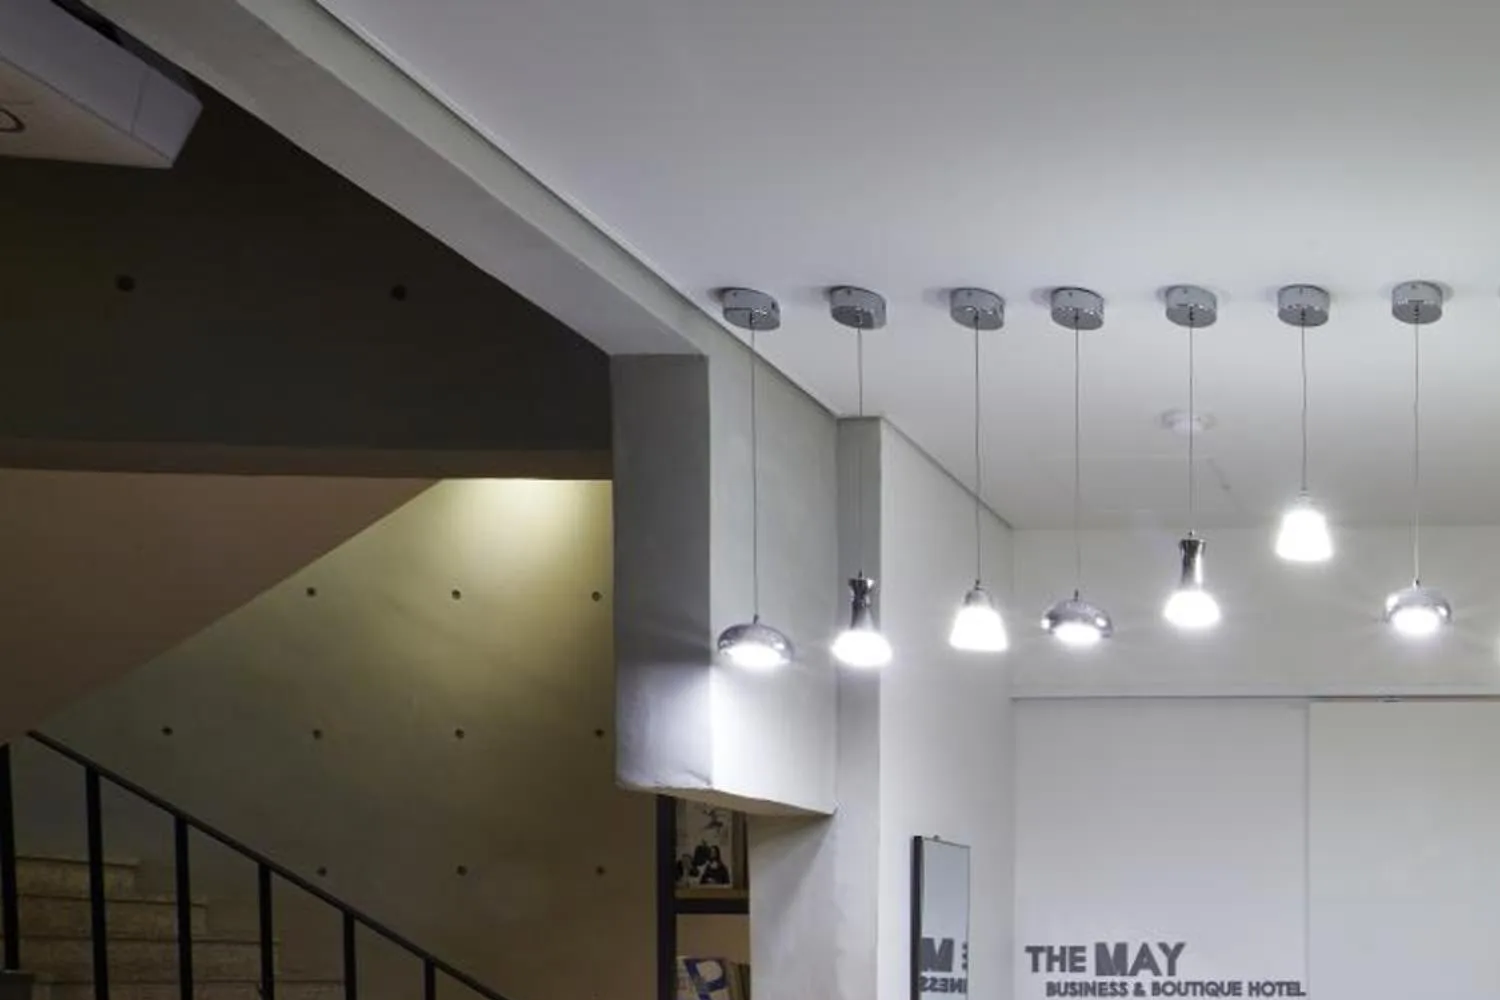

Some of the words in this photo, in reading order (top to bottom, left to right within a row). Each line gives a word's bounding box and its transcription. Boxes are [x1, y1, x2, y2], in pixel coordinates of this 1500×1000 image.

[1025, 945, 1086, 973] THE
[1095, 942, 1186, 976] MAY
[1046, 981, 1129, 997] BUSINESS
[1133, 982, 1146, 997] &
[1152, 981, 1242, 997] BOUTIQUE
[1249, 981, 1306, 997] HOTEL
